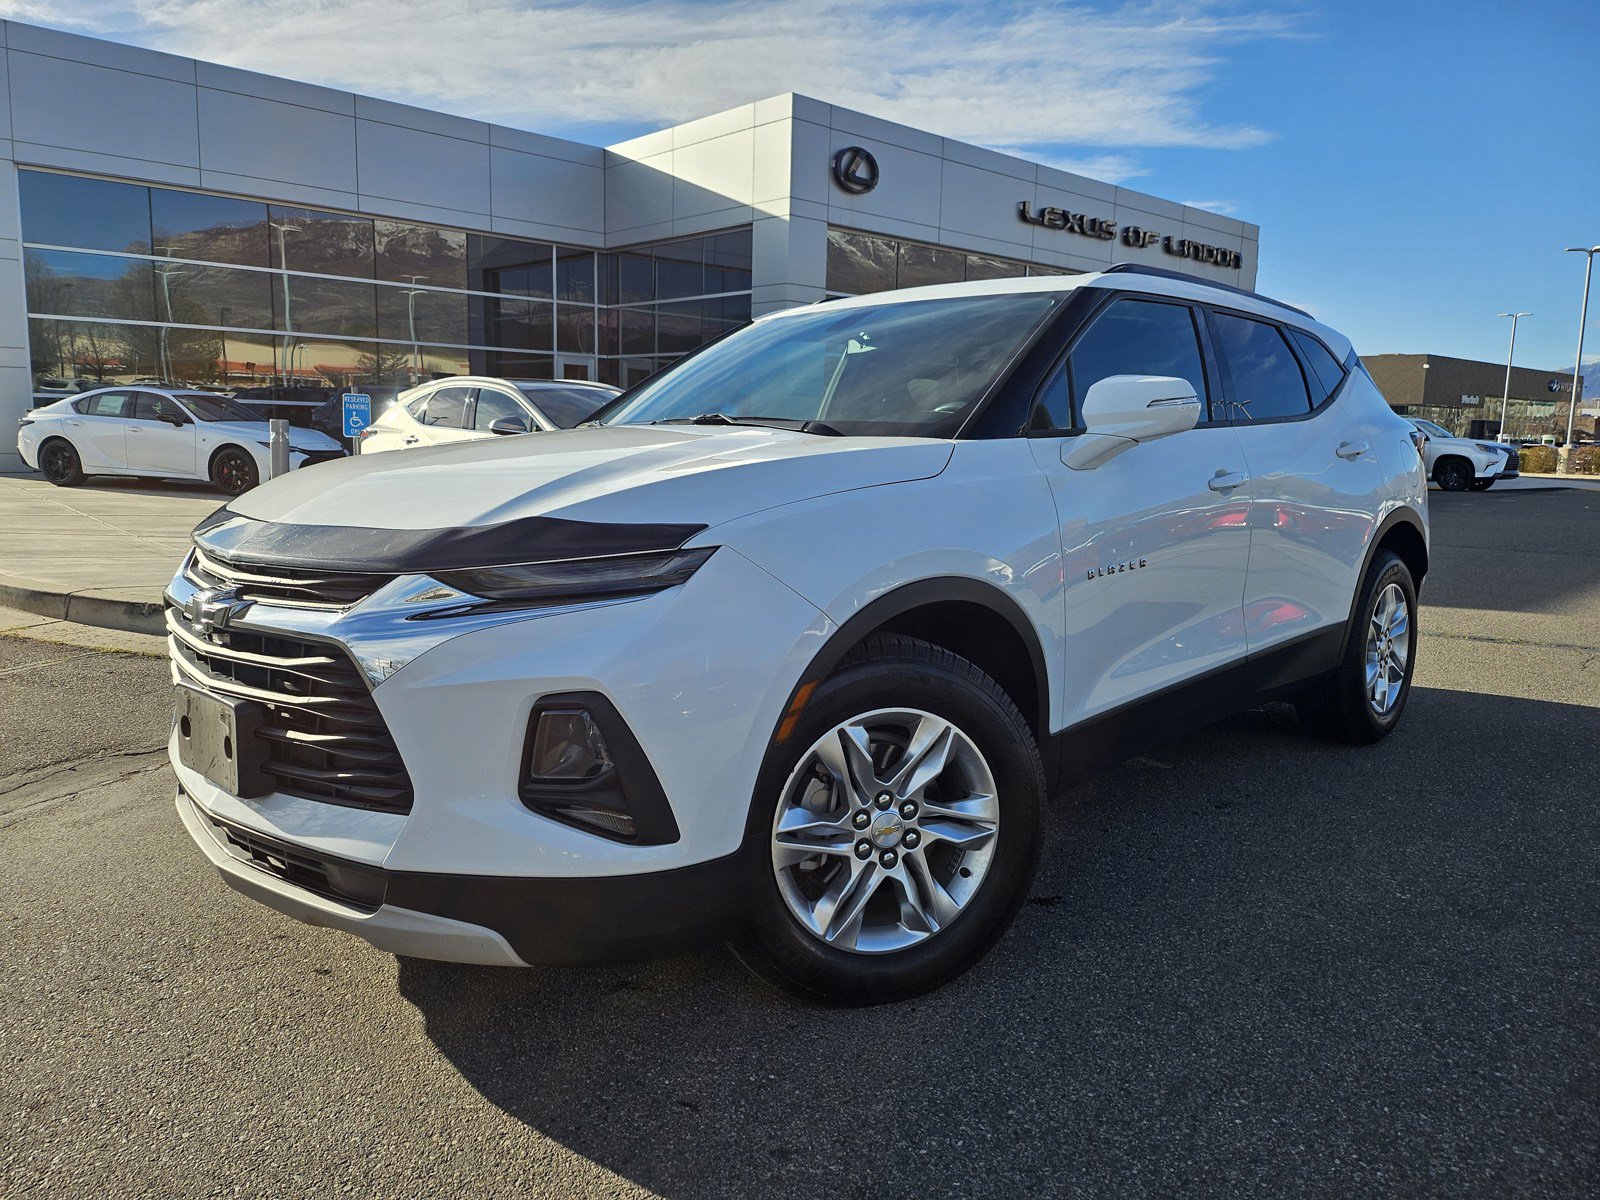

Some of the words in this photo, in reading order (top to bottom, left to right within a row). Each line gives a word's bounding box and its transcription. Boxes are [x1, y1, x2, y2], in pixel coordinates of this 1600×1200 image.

[1018, 200, 1118, 241] LEXUS
[1121, 225, 1160, 249] OF
[1163, 235, 1244, 270] LINDON
[345, 403, 368, 411] PARKING
[1087, 557, 1147, 580] BLAZER
